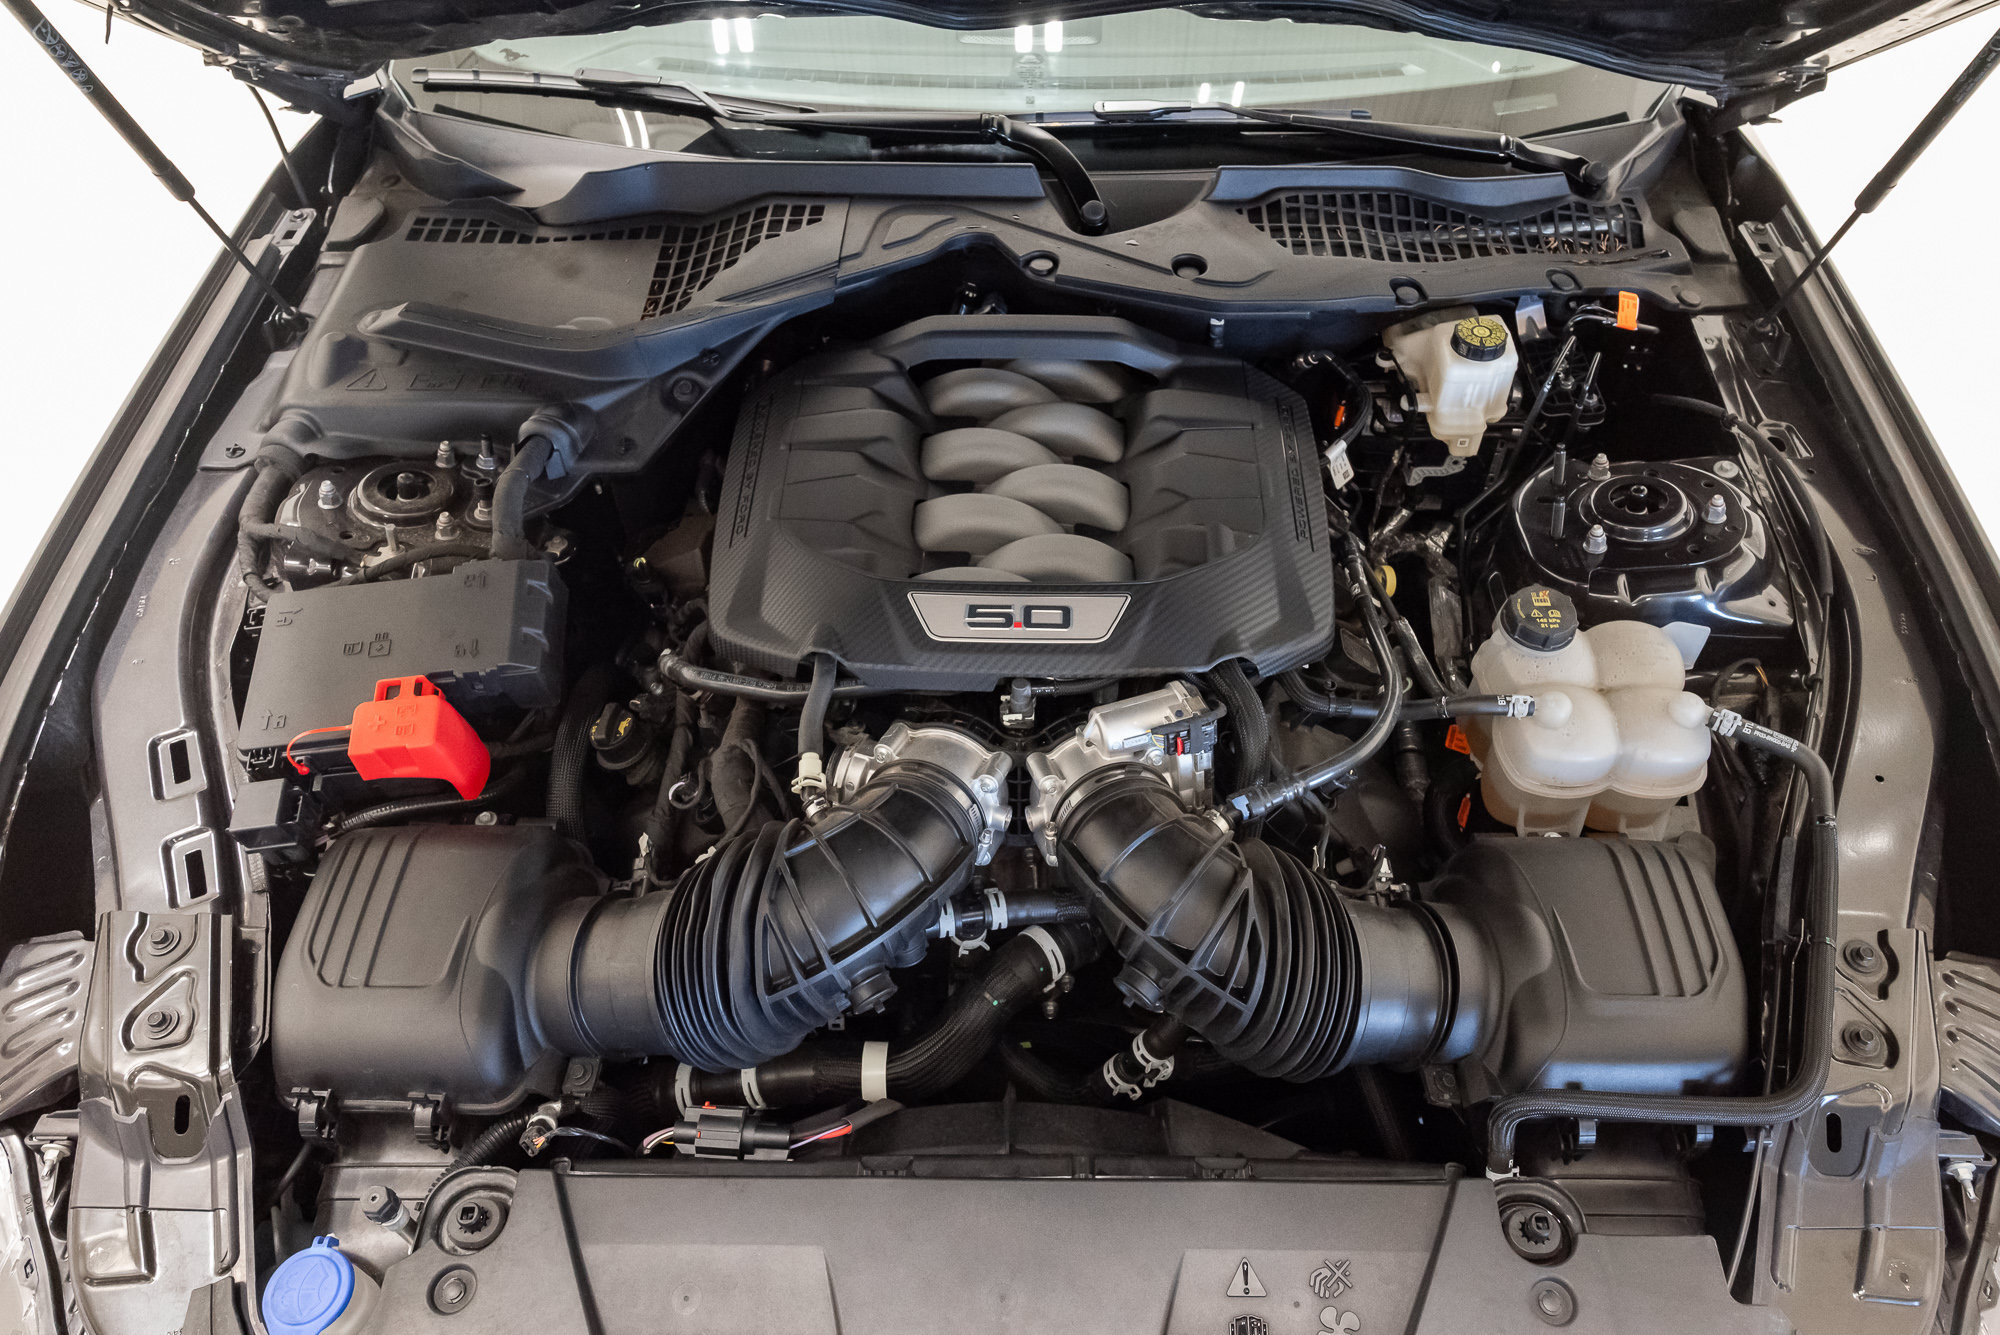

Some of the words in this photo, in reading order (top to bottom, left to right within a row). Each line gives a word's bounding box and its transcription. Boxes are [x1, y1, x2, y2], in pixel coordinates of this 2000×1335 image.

[735, 495, 751, 535] FORD
[1291, 467, 1309, 540] POWERED
[965, 604, 1073, 631] 5.0
